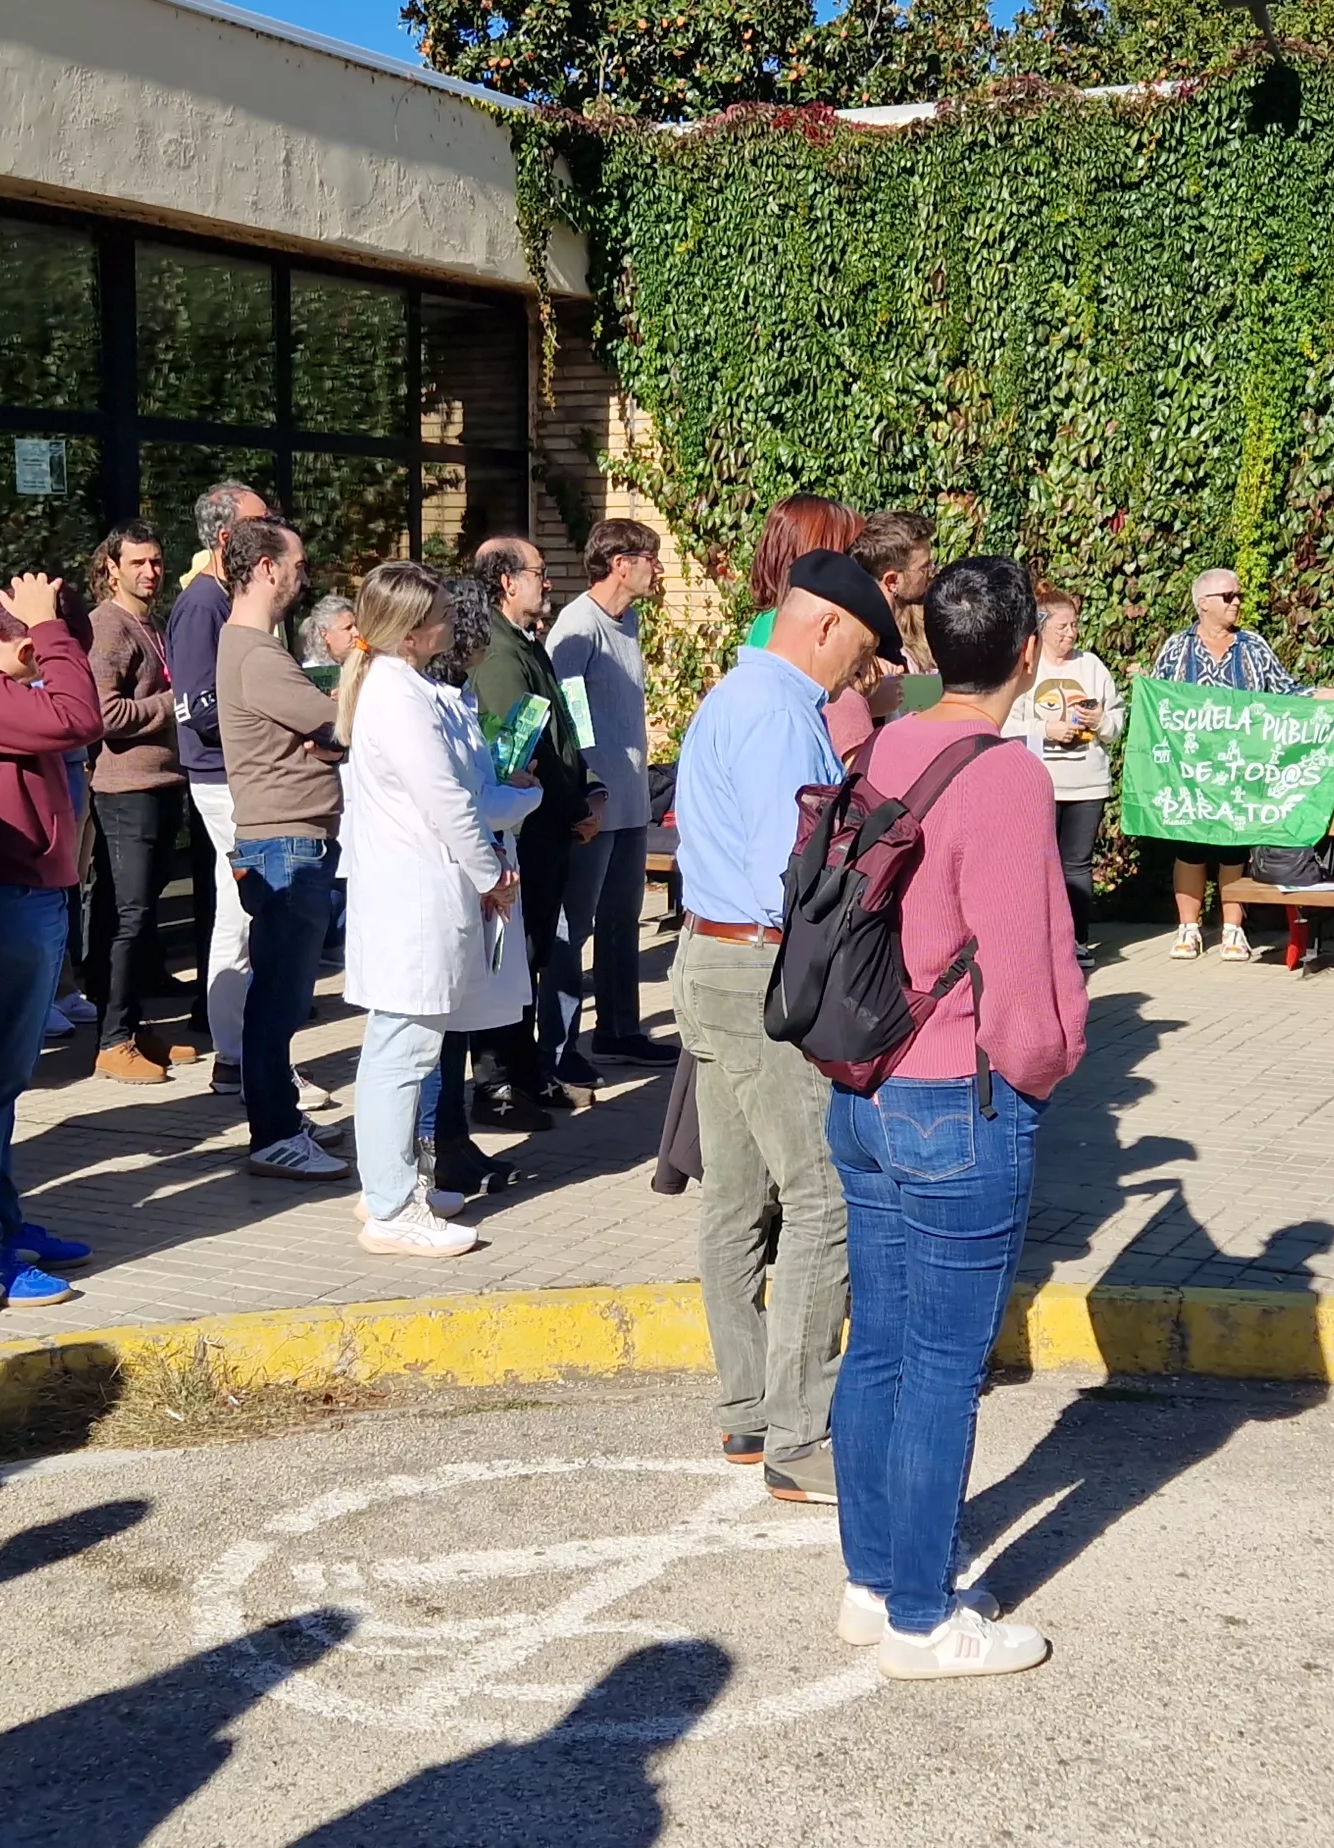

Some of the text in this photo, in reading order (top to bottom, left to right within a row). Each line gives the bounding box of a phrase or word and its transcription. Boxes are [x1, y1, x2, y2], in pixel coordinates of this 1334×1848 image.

[1159, 705, 1253, 736] ESCUELA
[1179, 760, 1321, 789] DE TOD@S
[1163, 800, 1235, 822] PARA
